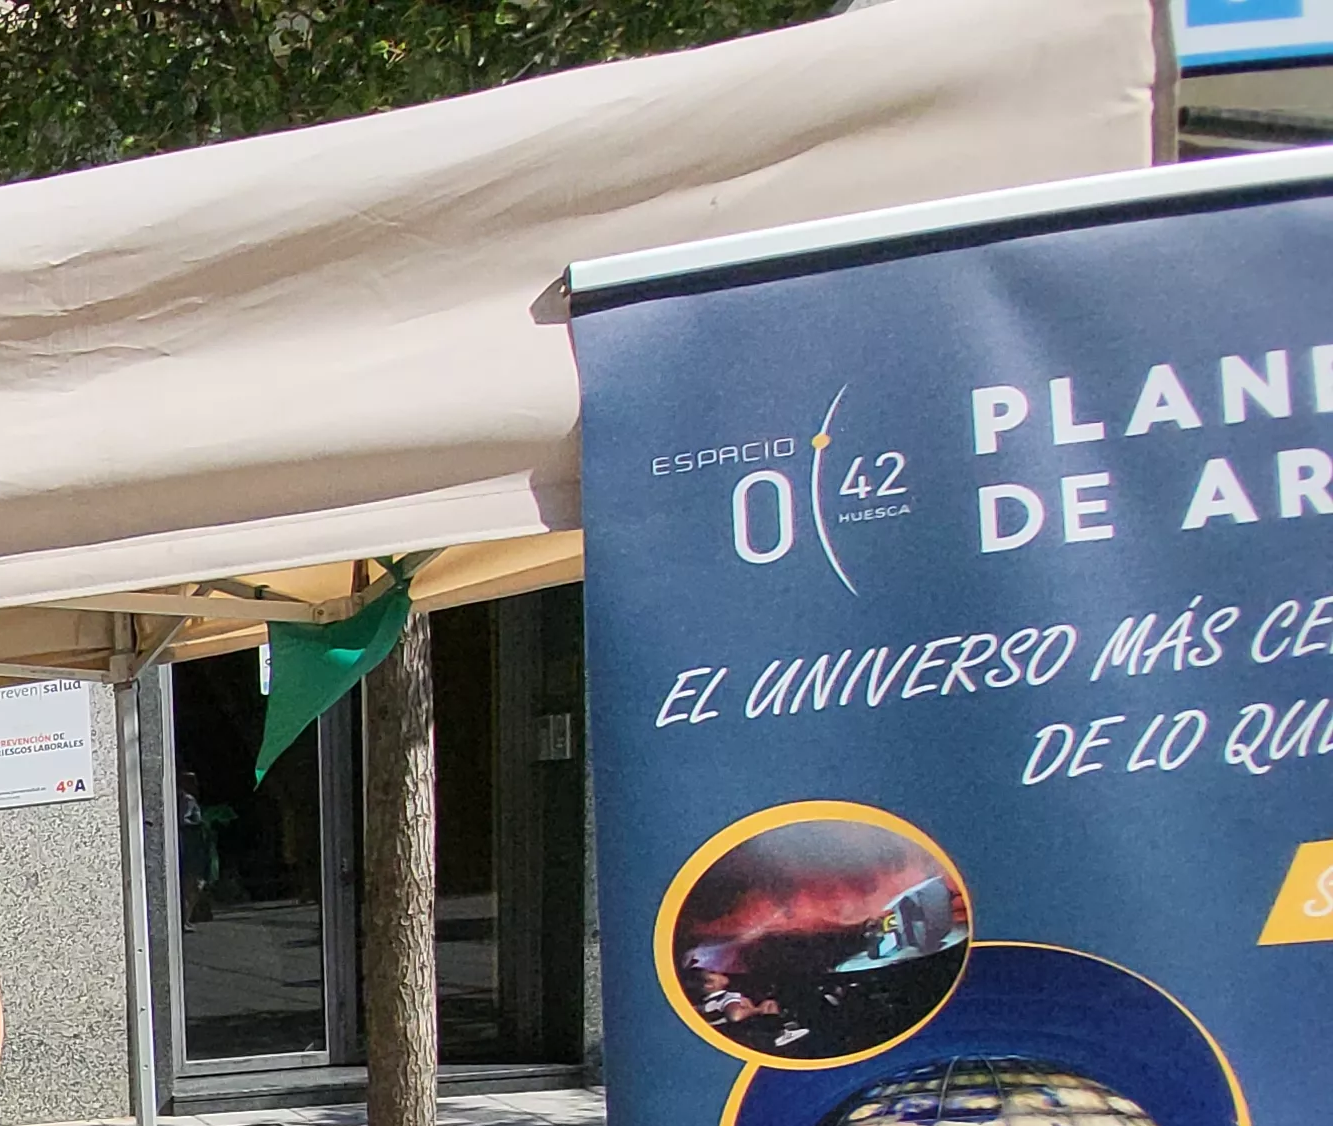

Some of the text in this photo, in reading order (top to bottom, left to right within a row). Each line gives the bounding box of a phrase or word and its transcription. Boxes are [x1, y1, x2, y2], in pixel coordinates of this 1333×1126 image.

[651, 436, 796, 477] ESPACIO
[838, 450, 910, 500] 42
[838, 503, 912, 524] HUESCA
[978, 447, 1333, 555] DE AR
[654, 594, 1333, 729] EL UNIVERSO MÁS CE
[33, 739, 84, 753] LABORALES
[52, 732, 65, 741] DE
[1021, 714, 1127, 787] DE
[1127, 709, 1209, 776] LO
